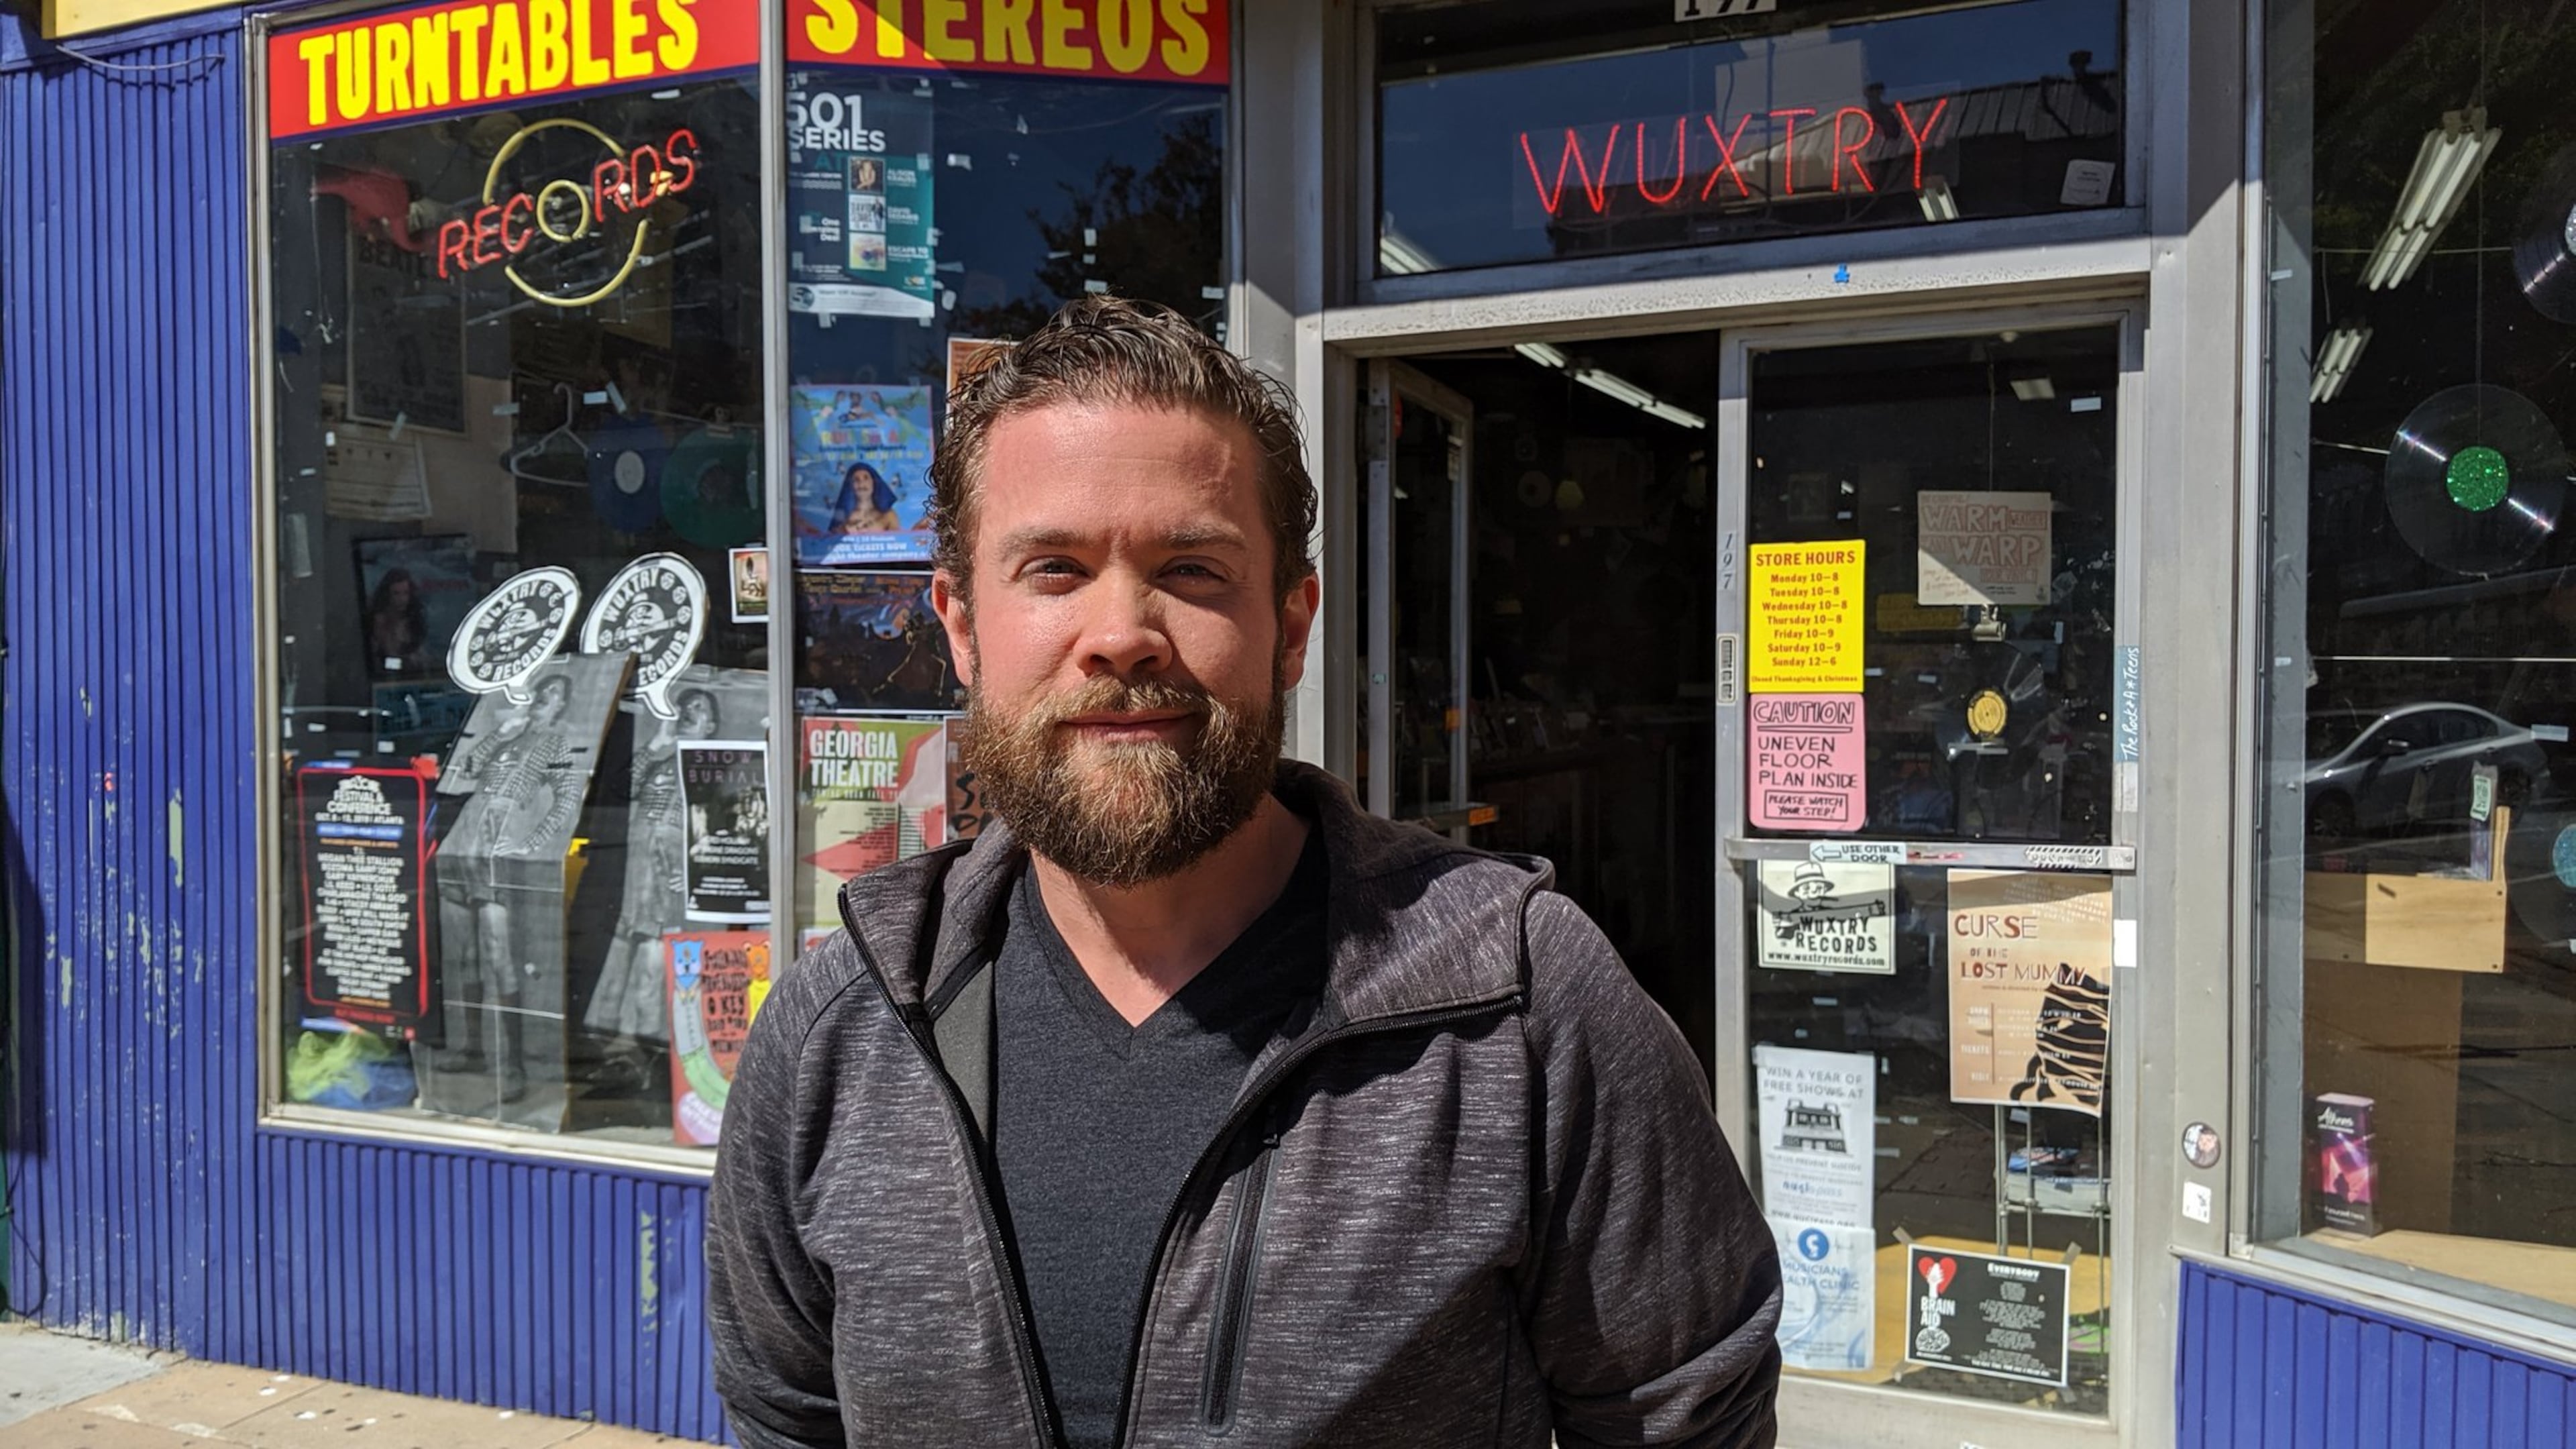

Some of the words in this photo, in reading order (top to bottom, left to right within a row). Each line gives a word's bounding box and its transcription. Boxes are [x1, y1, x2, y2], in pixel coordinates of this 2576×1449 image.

[806, 0, 1210, 76] STEREOS
[300, 0, 698, 125] TURNTABLES
[788, 127, 886, 152] SERIES
[1520, 97, 1949, 215] WUXTRY
[437, 129, 699, 278] RECORDS
[1923, 504, 2008, 533] WARM
[1756, 553, 1801, 567] STORE
[1806, 550, 1856, 565] HOURS
[1949, 534, 2041, 567] WARP
[1770, 574, 1807, 584] Monday
[604, 568, 659, 623] WUXTRY
[1770, 588, 1808, 598] Tuesday
[1762, 602, 1816, 612] Wednesday
[1768, 616, 1811, 625] Thursday
[1774, 630, 1803, 639] Friday
[492, 627, 558, 683] RECORDS
[638, 629, 689, 686] ECORDS
[1768, 643, 1811, 653] Saturday
[1772, 657, 1806, 667] Sunday
[1754, 700, 1856, 724] CAUTION
[810, 729, 898, 759] GEORGIA
[1758, 736, 1835, 753] UNEVEN
[2121, 737, 2139, 760] The
[695, 750, 752, 764] SNOW
[1759, 753, 1833, 769] FLOOR
[688, 768, 759, 786] BURIAL
[810, 759, 898, 788] THEATRE
[1759, 770, 1805, 787] PLAN
[1811, 773, 1858, 788] INSIDE
[1768, 794, 1805, 804] PLEASE
[1809, 796, 1843, 808] WATCH
[1778, 806, 1801, 816] YOUR
[1841, 845, 1863, 854] USE
[1864, 845, 1900, 855] OTHER
[1851, 854, 1888, 863] DOOR
[1800, 916, 1870, 936] WUXTRY
[1954, 914, 2038, 938] CURSE
[1796, 932, 1878, 955] RECORDS
[1768, 951, 1885, 967] www.wuxtryrecords.com
[1960, 961, 2008, 980] LOST
[2015, 963, 2086, 986] MUMMY
[1766, 1067, 1791, 1078] WIN
[1796, 1069, 1804, 1079] A
[1809, 1070, 1840, 1083] YEAR
[1845, 1073, 1862, 1085] OF
[1764, 1079, 1792, 1093] FREE
[1797, 1083, 1844, 1098] SHOWS
[1848, 1087, 1864, 1099] AT
[1921, 1295, 1955, 1316] BRAIN
[1920, 1311, 1942, 1328] AID
